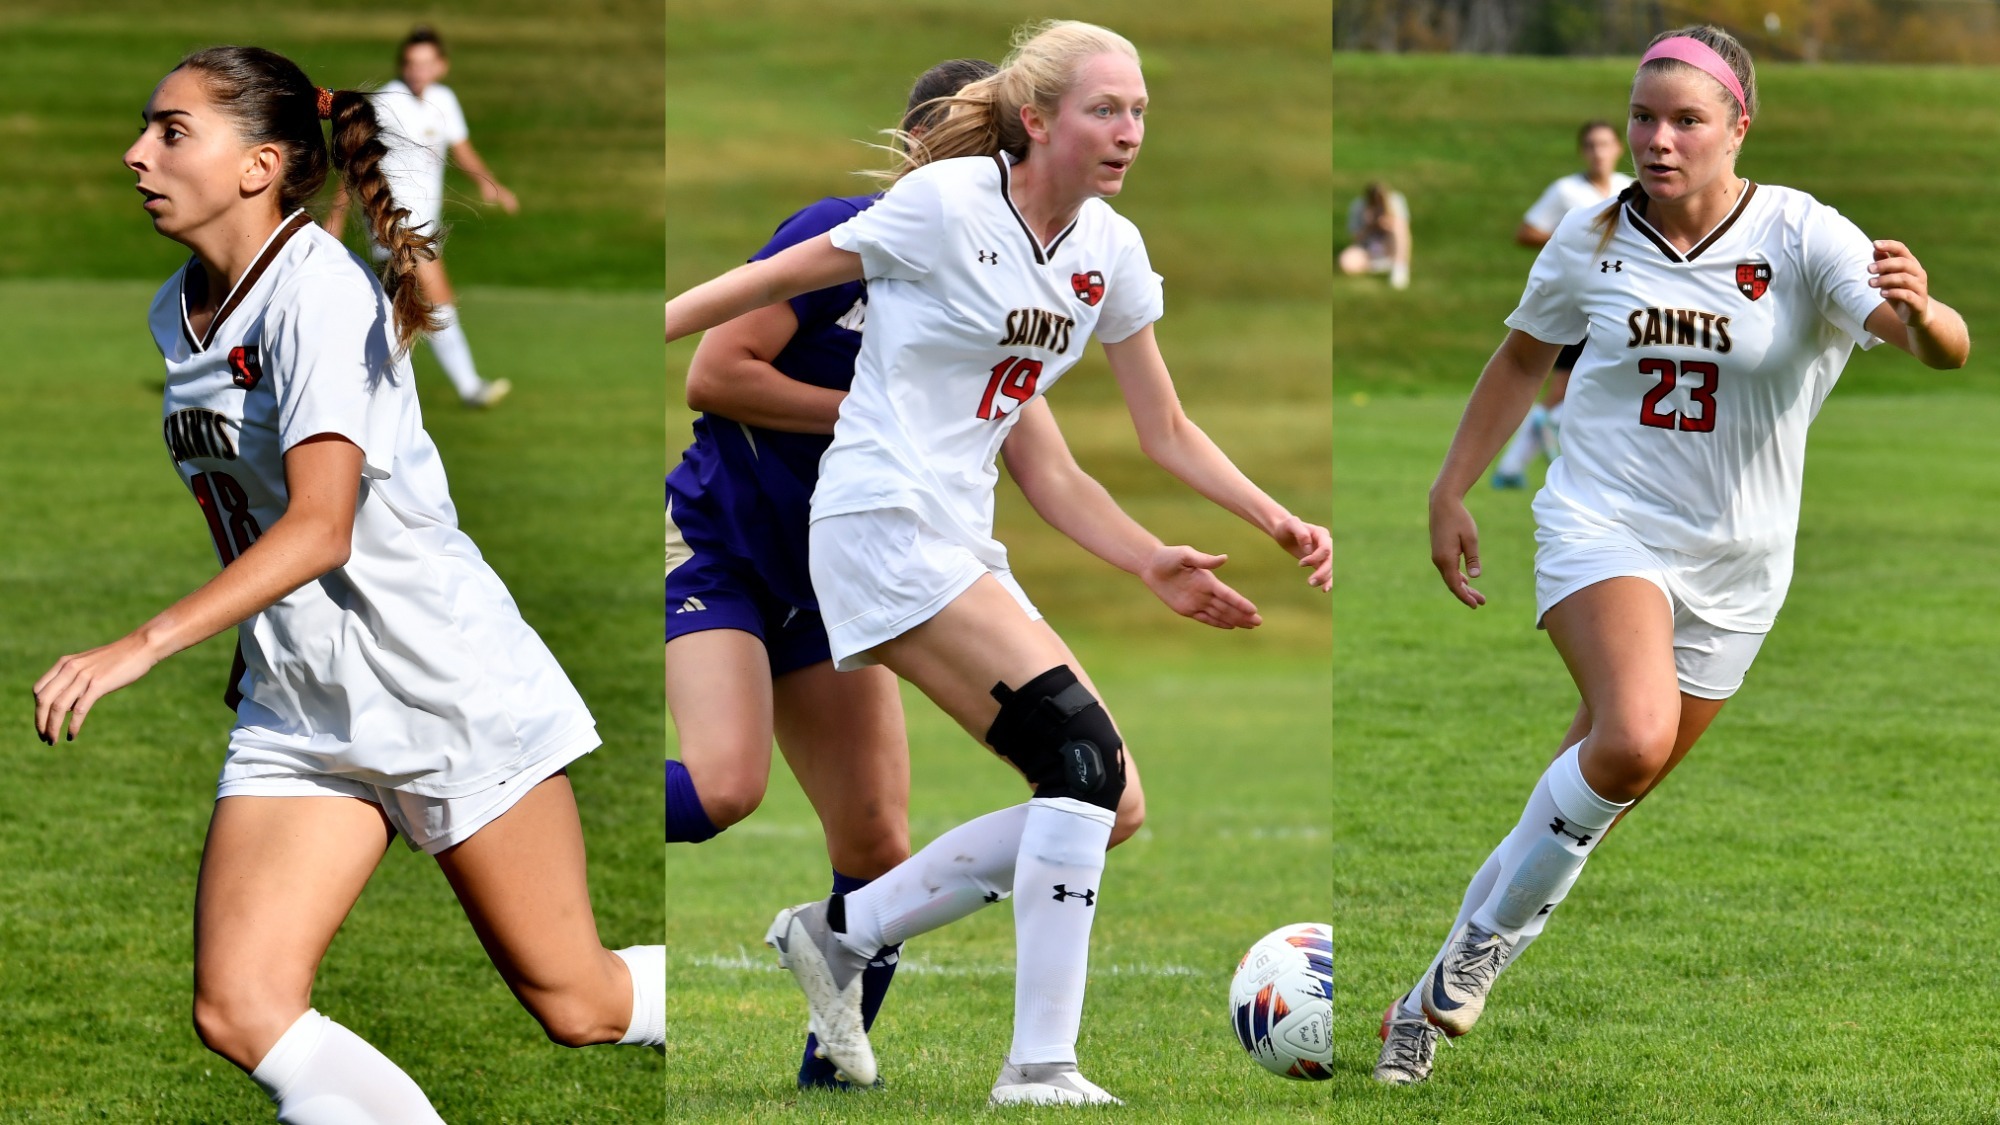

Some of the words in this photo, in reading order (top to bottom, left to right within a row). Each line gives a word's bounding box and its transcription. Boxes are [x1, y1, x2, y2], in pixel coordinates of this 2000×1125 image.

[998, 307, 1075, 355] SAINTS
[1627, 306, 1732, 354] SAINTS
[976, 356, 1043, 421] 19
[1638, 357, 1719, 433] 23
[191, 471, 263, 568] 18
[1298, 1025, 1309, 1043] Ball
[1310, 1020, 1319, 1045] Game
